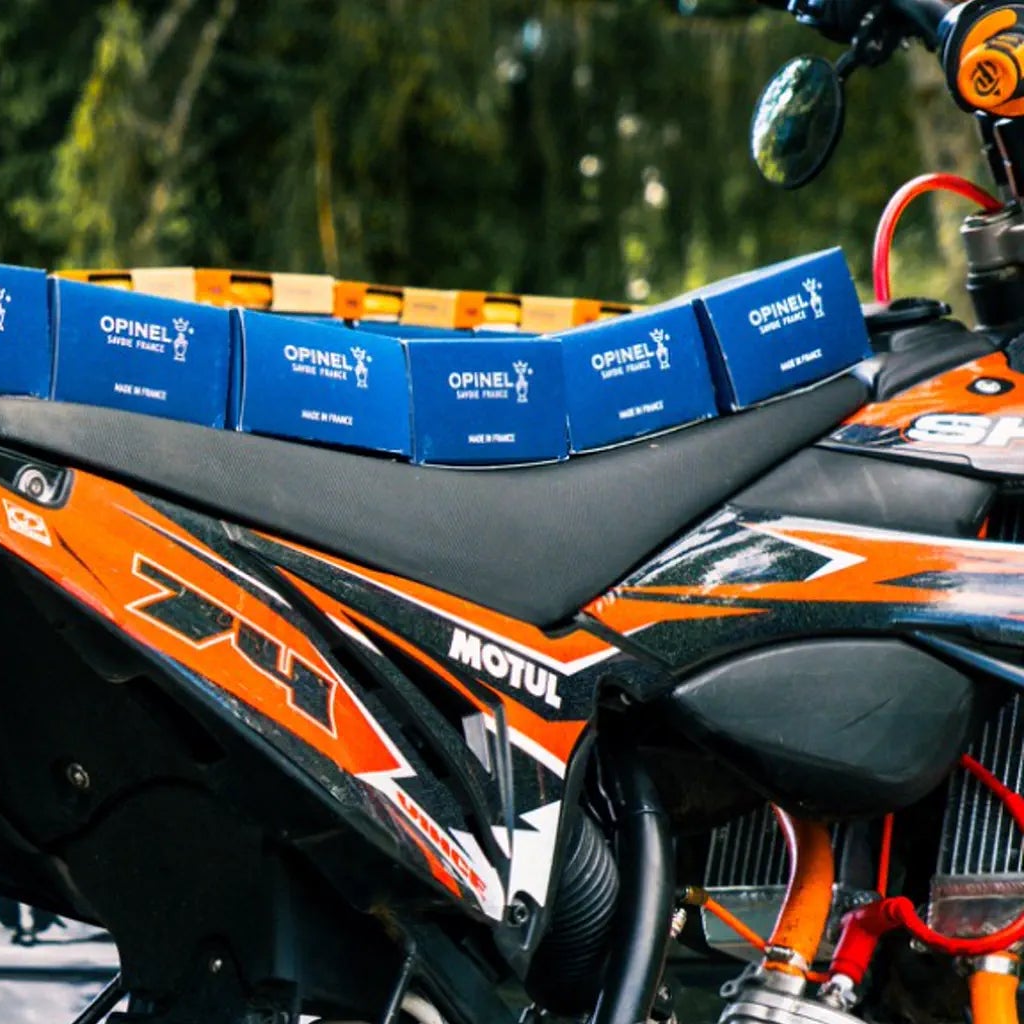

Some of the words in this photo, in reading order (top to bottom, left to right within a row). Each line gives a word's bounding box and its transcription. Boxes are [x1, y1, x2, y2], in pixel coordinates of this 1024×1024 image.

[748, 293, 809, 326] OPINEL
[100, 315, 172, 343] OPINEL
[284, 344, 353, 371] OPINEL
[591, 343, 655, 370] OPINEL
[448, 372, 514, 389] OPINEL
[448, 627, 562, 709] MOTUL
